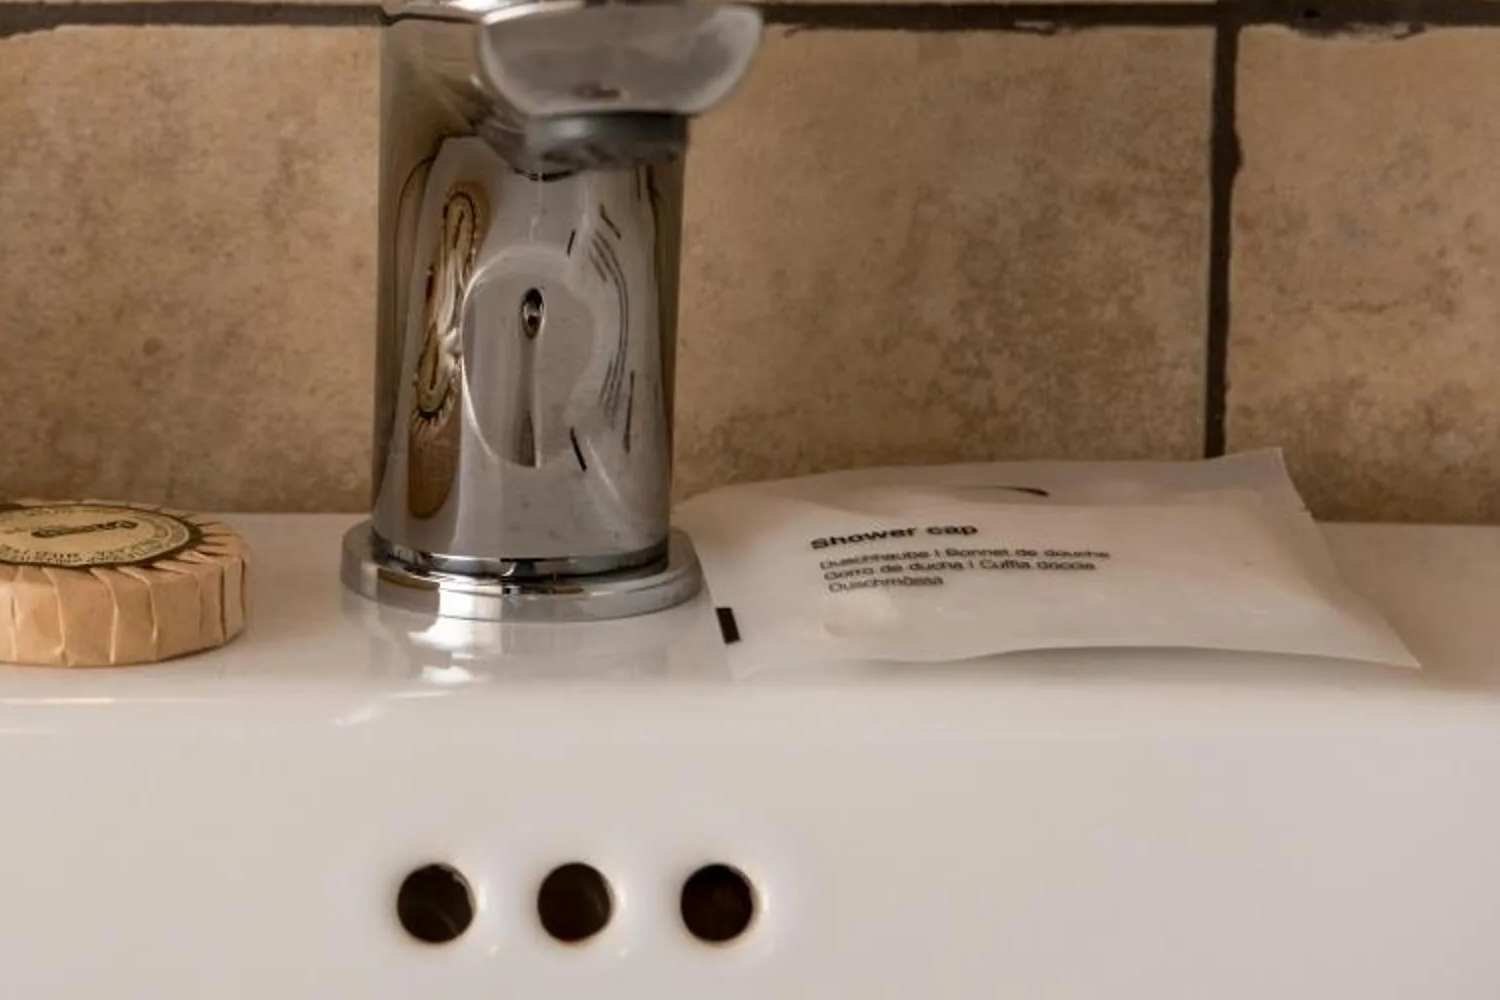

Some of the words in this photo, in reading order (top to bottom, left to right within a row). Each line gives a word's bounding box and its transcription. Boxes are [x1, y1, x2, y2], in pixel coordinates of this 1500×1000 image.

[810, 526, 918, 550] Shower
[926, 525, 978, 536] cap
[880, 564, 903, 574] de
